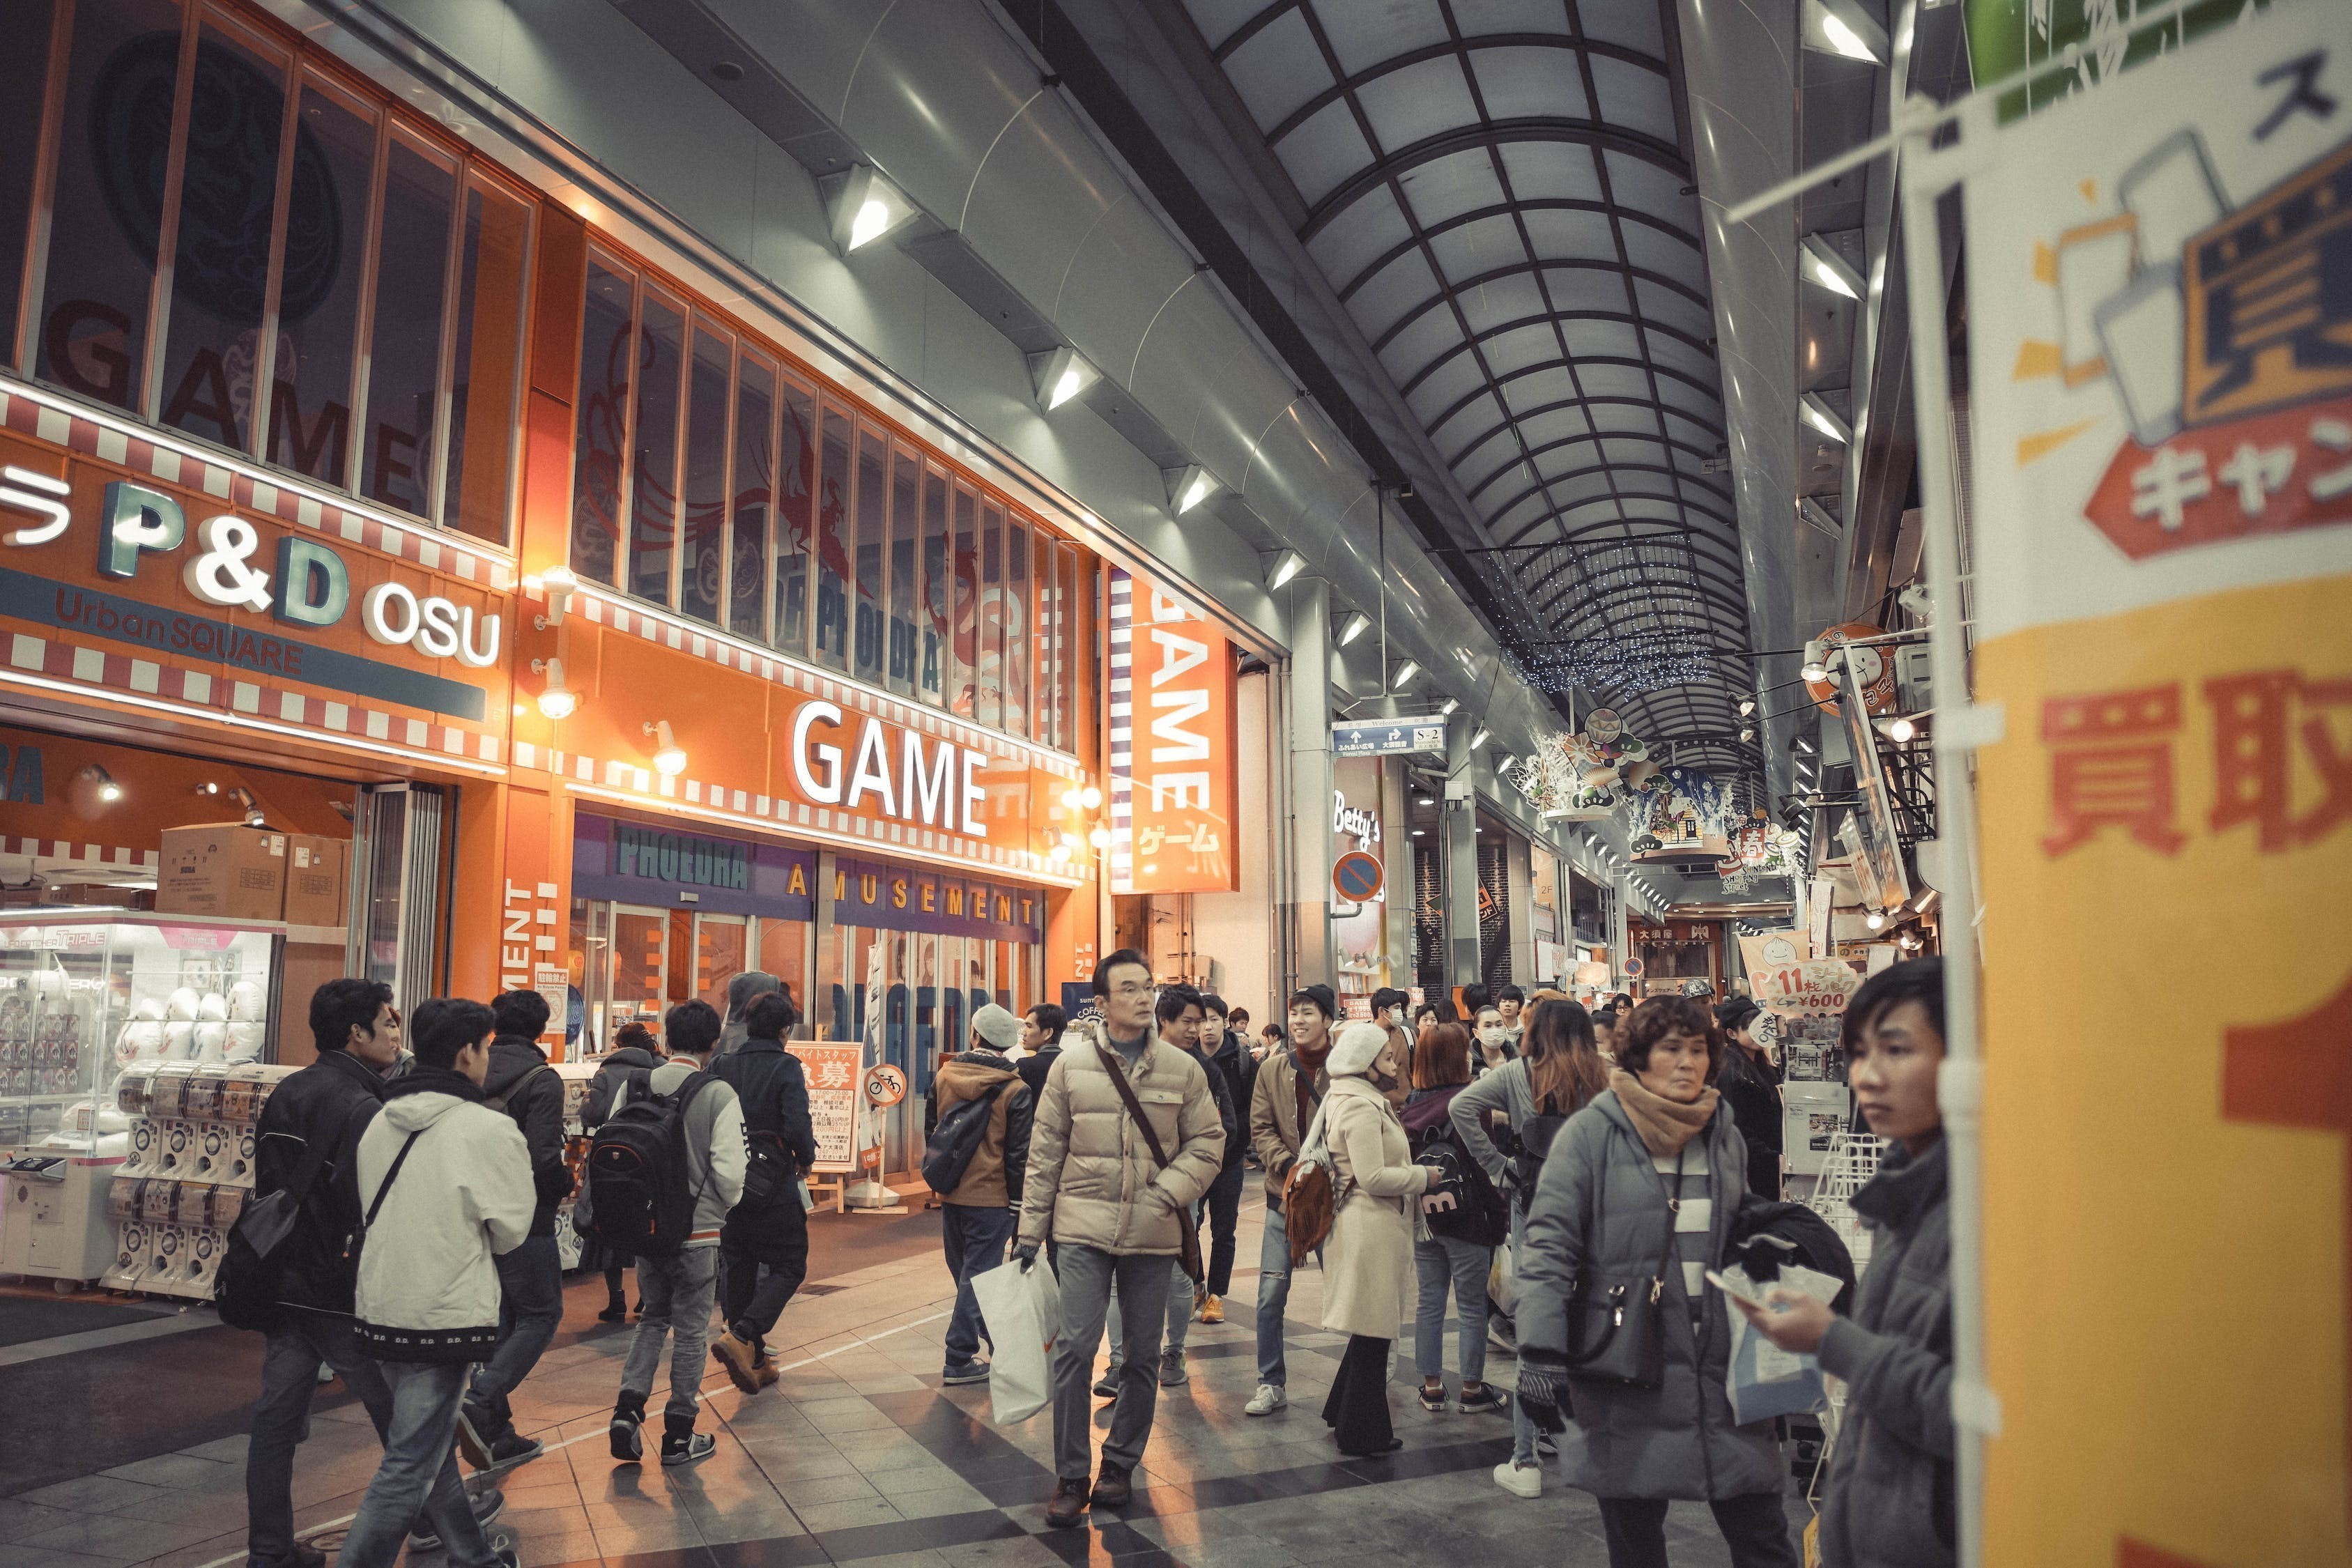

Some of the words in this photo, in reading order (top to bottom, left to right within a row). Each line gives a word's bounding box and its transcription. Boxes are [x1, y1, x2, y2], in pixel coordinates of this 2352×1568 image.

[46, 299, 417, 512] GAME
[54, 587, 165, 643] Urban
[169, 617, 303, 675] SQUARE
[362, 581, 501, 668] OSU
[1338, 742, 1374, 751] ふれあい広場
[790, 700, 988, 838] GAME
[2038, 668, 2352, 863] 買取
[1334, 789, 1380, 852] Betty's
[1139, 824, 1220, 855] ゲーム
[1743, 830, 1763, 856] 春
[617, 826, 748, 890] PHOEDRA
[786, 863, 1033, 925] AMUSEMENT
[1541, 886, 1553, 894] 2F
[56, 930, 105, 946] TRIPLE
[1639, 929, 1673, 939] 大須屋
[537, 972, 567, 983] 駐輪禁止
[1077, 1006, 1105, 1019] COFFE
[1798, 993, 1845, 1008] ¥600
[785, 1049, 856, 1061] ルバイトスタッフ
